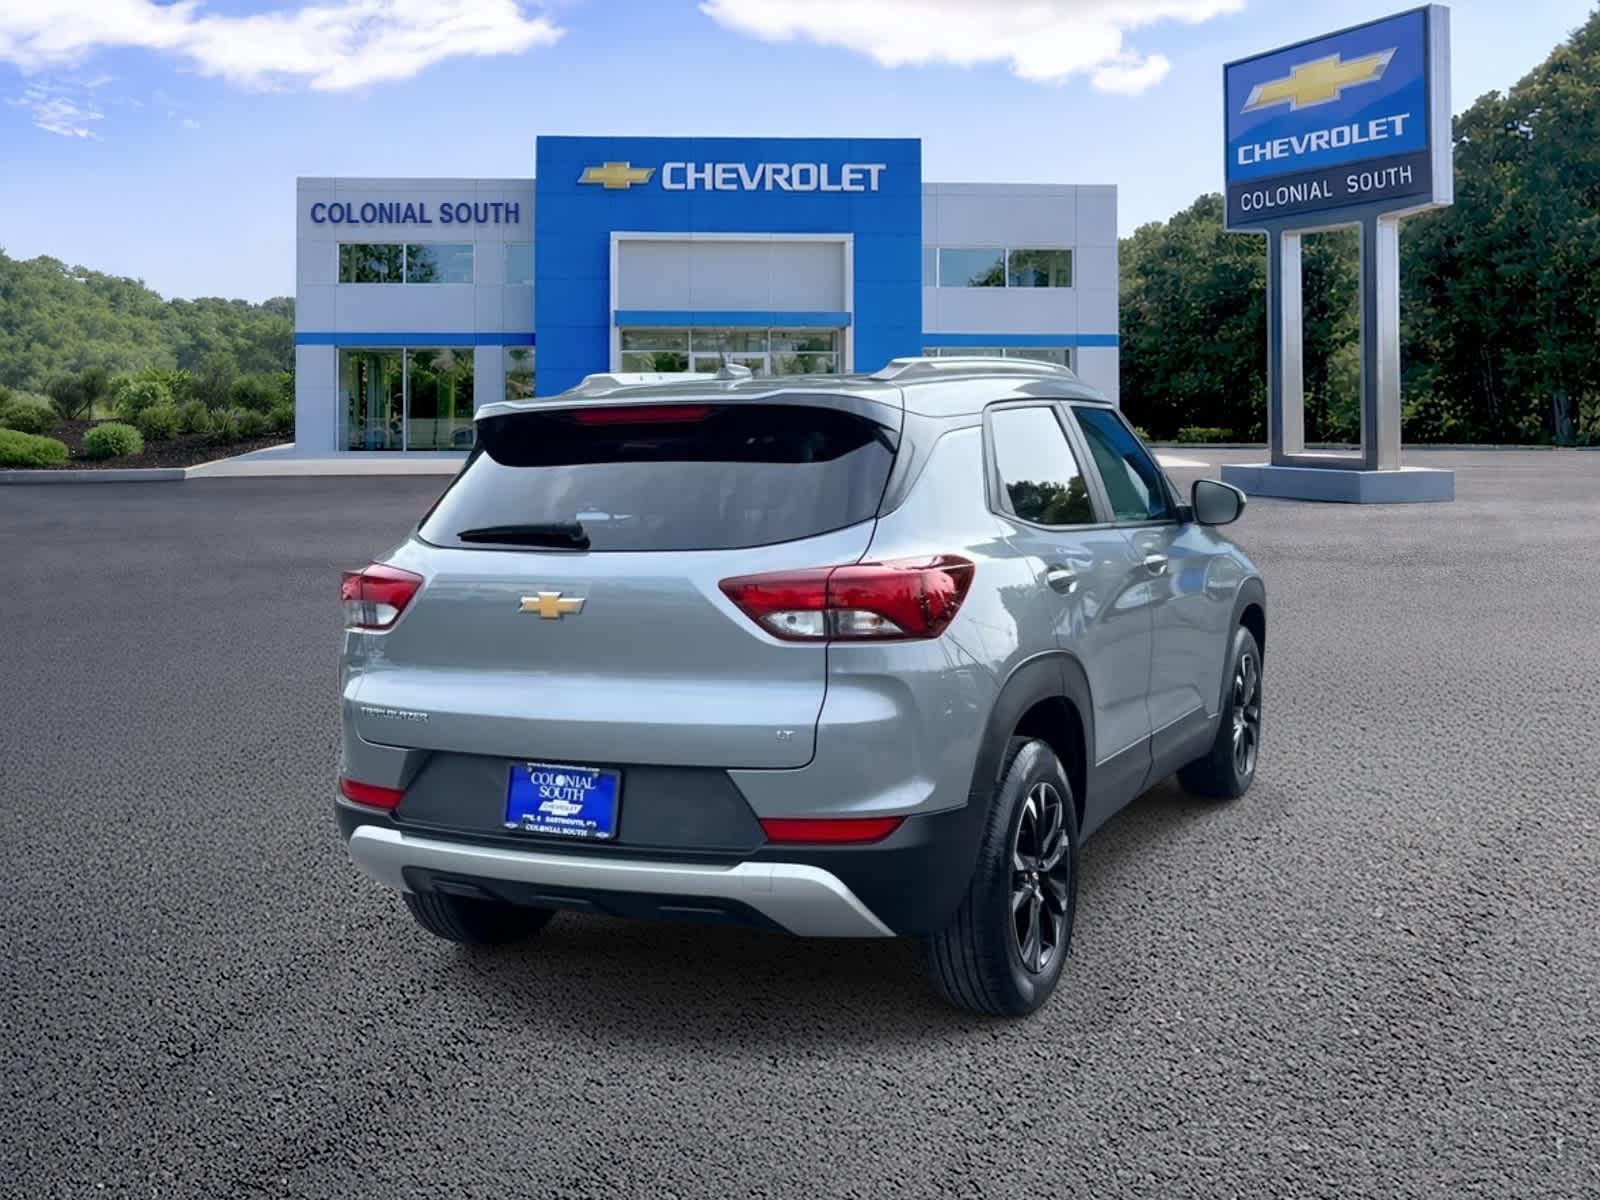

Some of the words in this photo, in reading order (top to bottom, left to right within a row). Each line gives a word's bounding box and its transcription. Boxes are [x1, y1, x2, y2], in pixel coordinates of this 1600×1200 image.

[1238, 113, 1410, 165] CHEVROLET
[661, 161, 886, 192] CHEVROLET
[1241, 180, 1332, 211] COLONIAL
[1347, 165, 1412, 193] SOUTH
[310, 202, 433, 224] COLONIAL
[439, 202, 520, 224] SOUTH
[531, 772, 596, 789] COLONIAL
[538, 786, 585, 801] SOUTH
